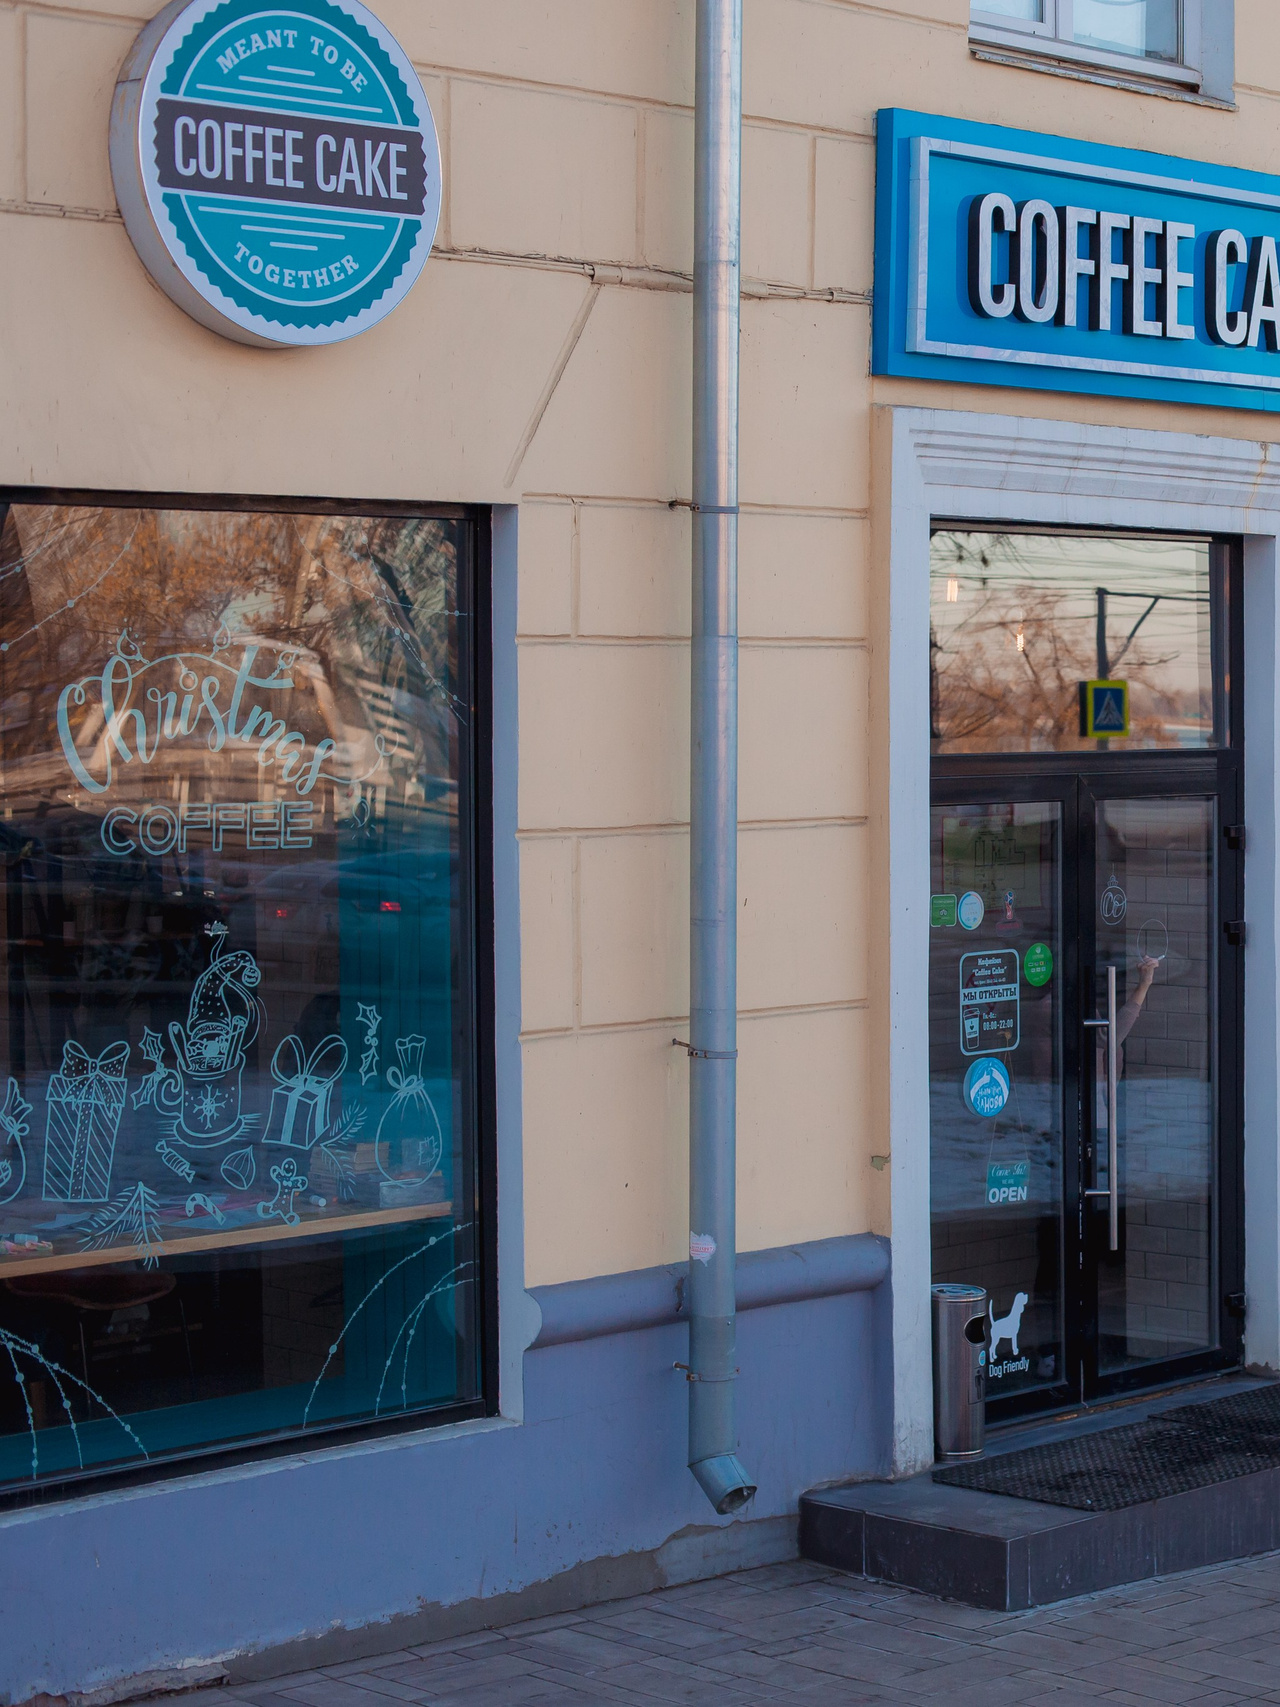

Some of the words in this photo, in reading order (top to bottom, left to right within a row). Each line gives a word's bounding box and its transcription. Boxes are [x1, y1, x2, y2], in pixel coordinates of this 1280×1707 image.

[215, 29, 298, 75] MEANT
[310, 36, 339, 65] TO
[341, 58, 369, 94] BE
[174, 115, 305, 189] COFFEE
[315, 134, 408, 201] CAKE
[234, 241, 360, 289] TOGETHER
[968, 192, 1195, 340] COFFEE
[57, 645, 398, 795] Christmas
[100, 801, 313, 856] COFFEE
[963, 991, 977, 1002] МЫ
[979, 987, 1017, 1000] ОТКРЫТЫ
[988, 1186, 1028, 1204] OPEN
[989, 1364, 1003, 1378] Dog
[1003, 1356, 1030, 1373] Friendly
